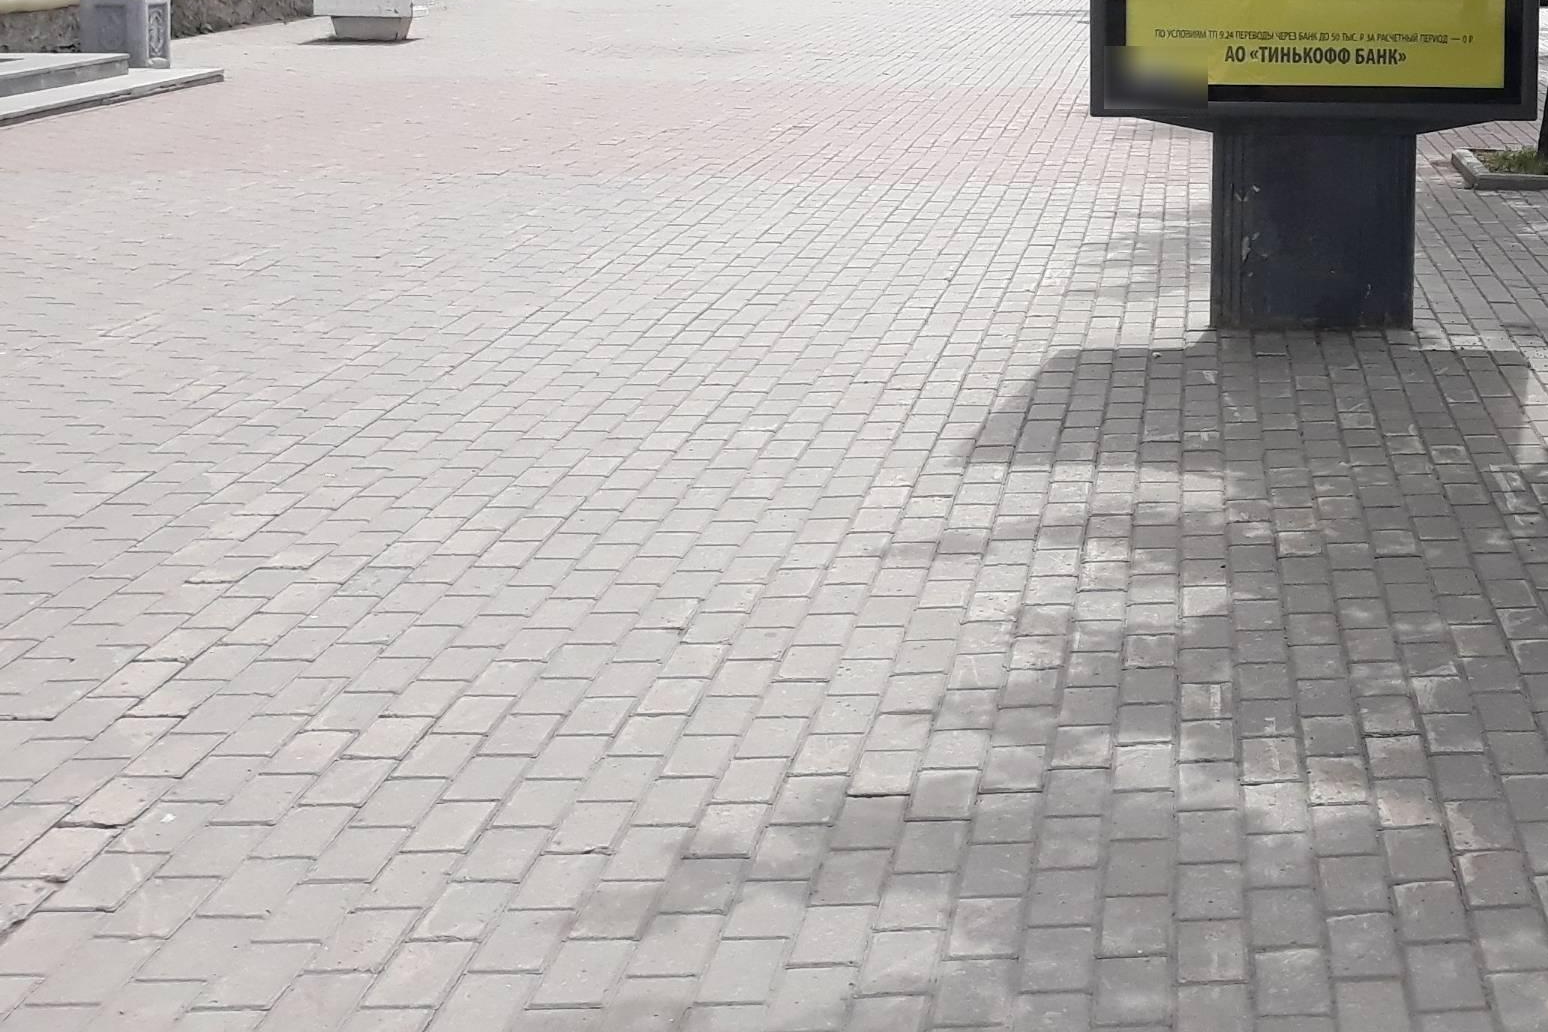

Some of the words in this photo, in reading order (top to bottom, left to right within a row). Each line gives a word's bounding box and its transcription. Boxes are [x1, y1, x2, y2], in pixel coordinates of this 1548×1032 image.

[1155, 29, 1166, 38] ПО
[1167, 29, 1207, 39] УСЛОВИЯМ
[1235, 31, 1274, 40] ПЕРЕВОДЫ
[1275, 31, 1297, 41] ЧЕРЕЗ
[1298, 32, 1318, 41] БАНК
[1319, 32, 1330, 42] ДО
[1331, 32, 1340, 42] 50
[1420, 34, 1448, 44] ПЕРИОД
[1224, 46, 1246, 63] АО
[1250, 46, 1351, 64] «ТИНЬКОФФ
[1355, 48, 1407, 65] БАНК»
